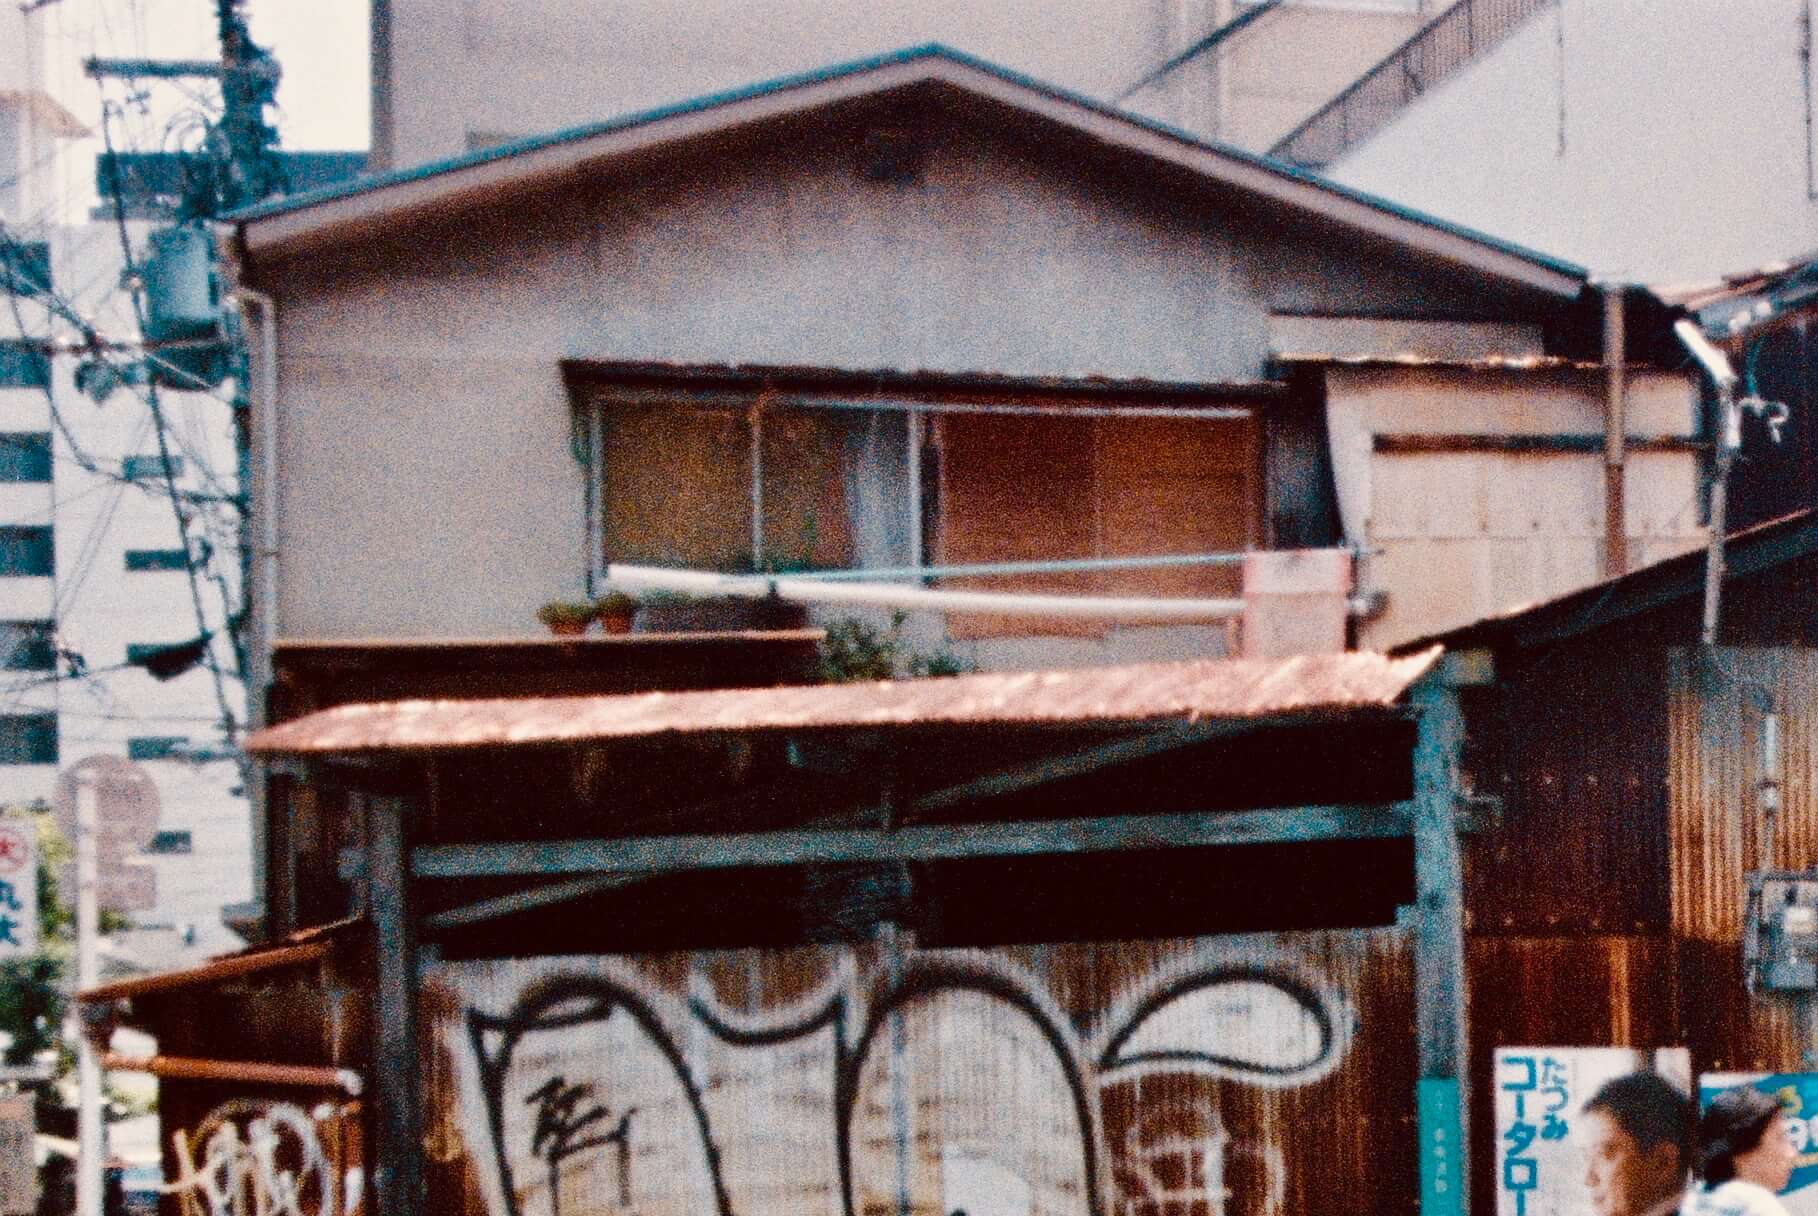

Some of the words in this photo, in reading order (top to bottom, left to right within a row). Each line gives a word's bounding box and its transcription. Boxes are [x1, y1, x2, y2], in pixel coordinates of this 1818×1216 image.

[1501, 1056, 1537, 1216] コータロー
[1541, 1056, 1569, 1140] たつみ
